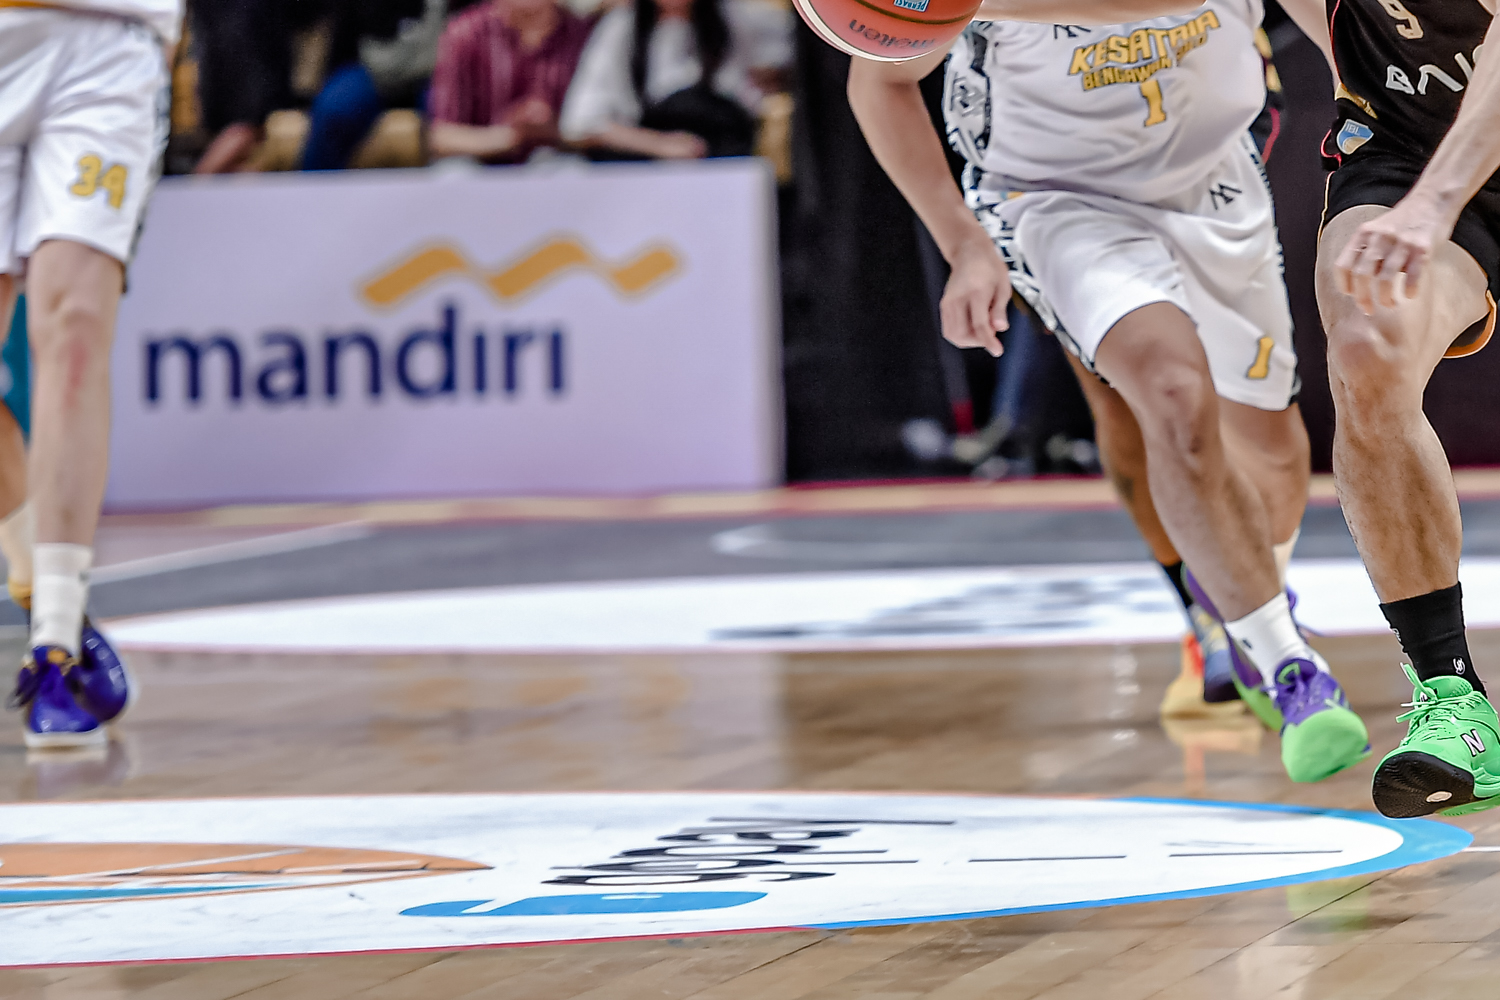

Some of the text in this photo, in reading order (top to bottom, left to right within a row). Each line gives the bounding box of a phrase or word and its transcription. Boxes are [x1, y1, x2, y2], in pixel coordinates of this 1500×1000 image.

[849, 18, 937, 49] molten
[1067, 9, 1221, 76] KESATRIA
[1139, 78, 1168, 128] 1
[142, 300, 568, 404] mandiri
[1245, 335, 1274, 380] 1
[1460, 728, 1488, 757] N
